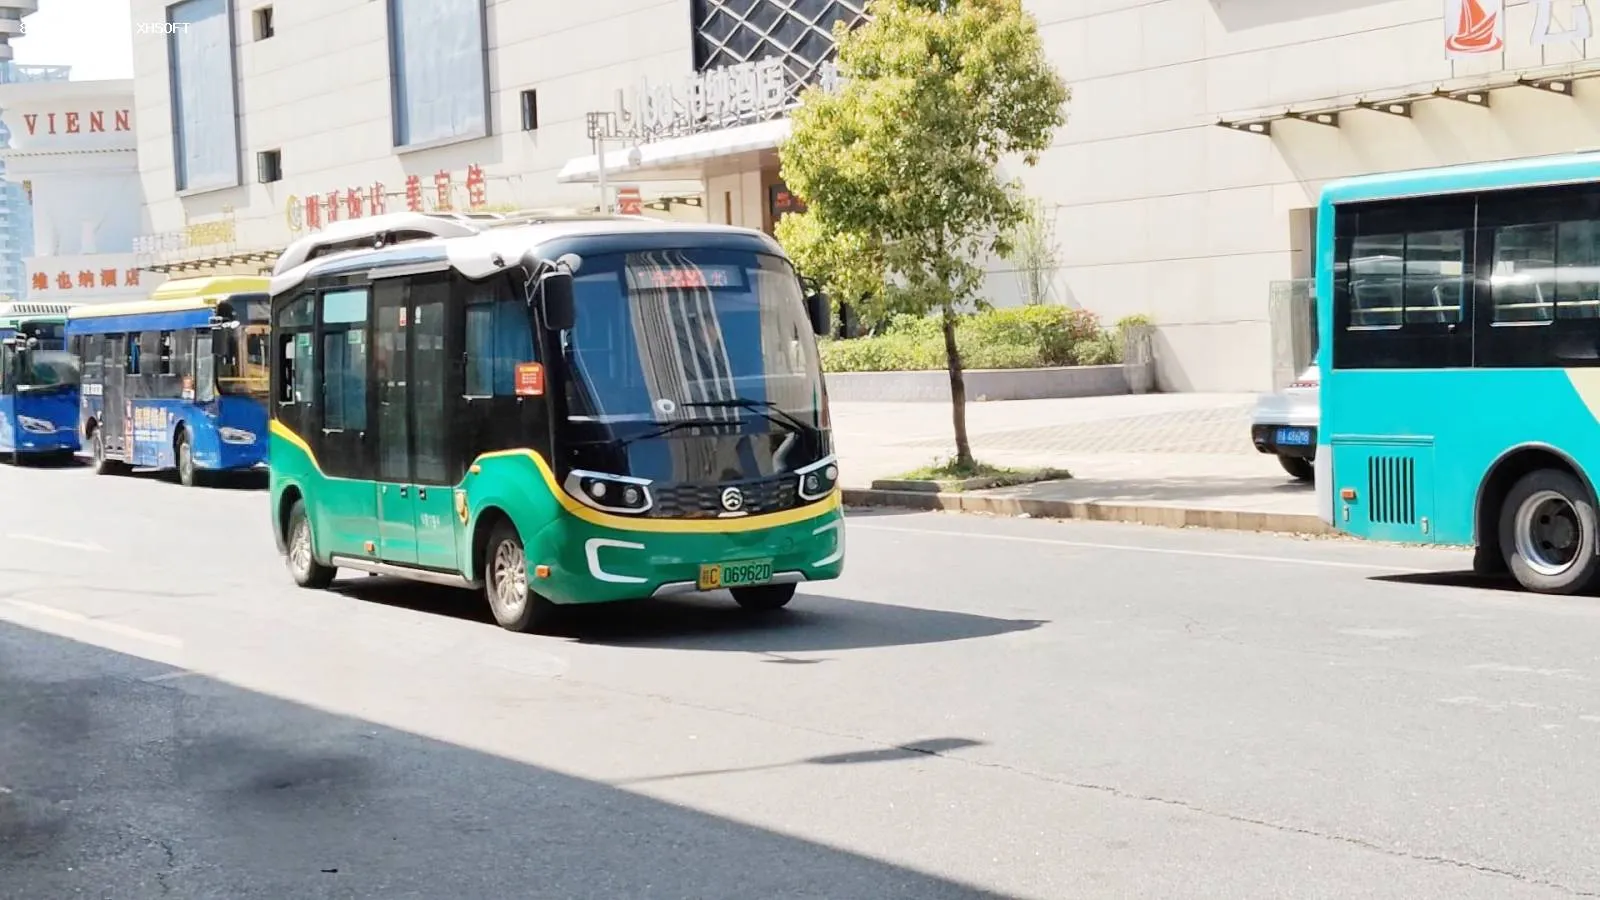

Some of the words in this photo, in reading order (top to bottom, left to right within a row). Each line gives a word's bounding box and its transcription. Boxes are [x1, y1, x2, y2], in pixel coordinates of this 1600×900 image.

[24, 110, 131, 135] VIENN
[32, 268, 141, 290] 维也纳酒店
